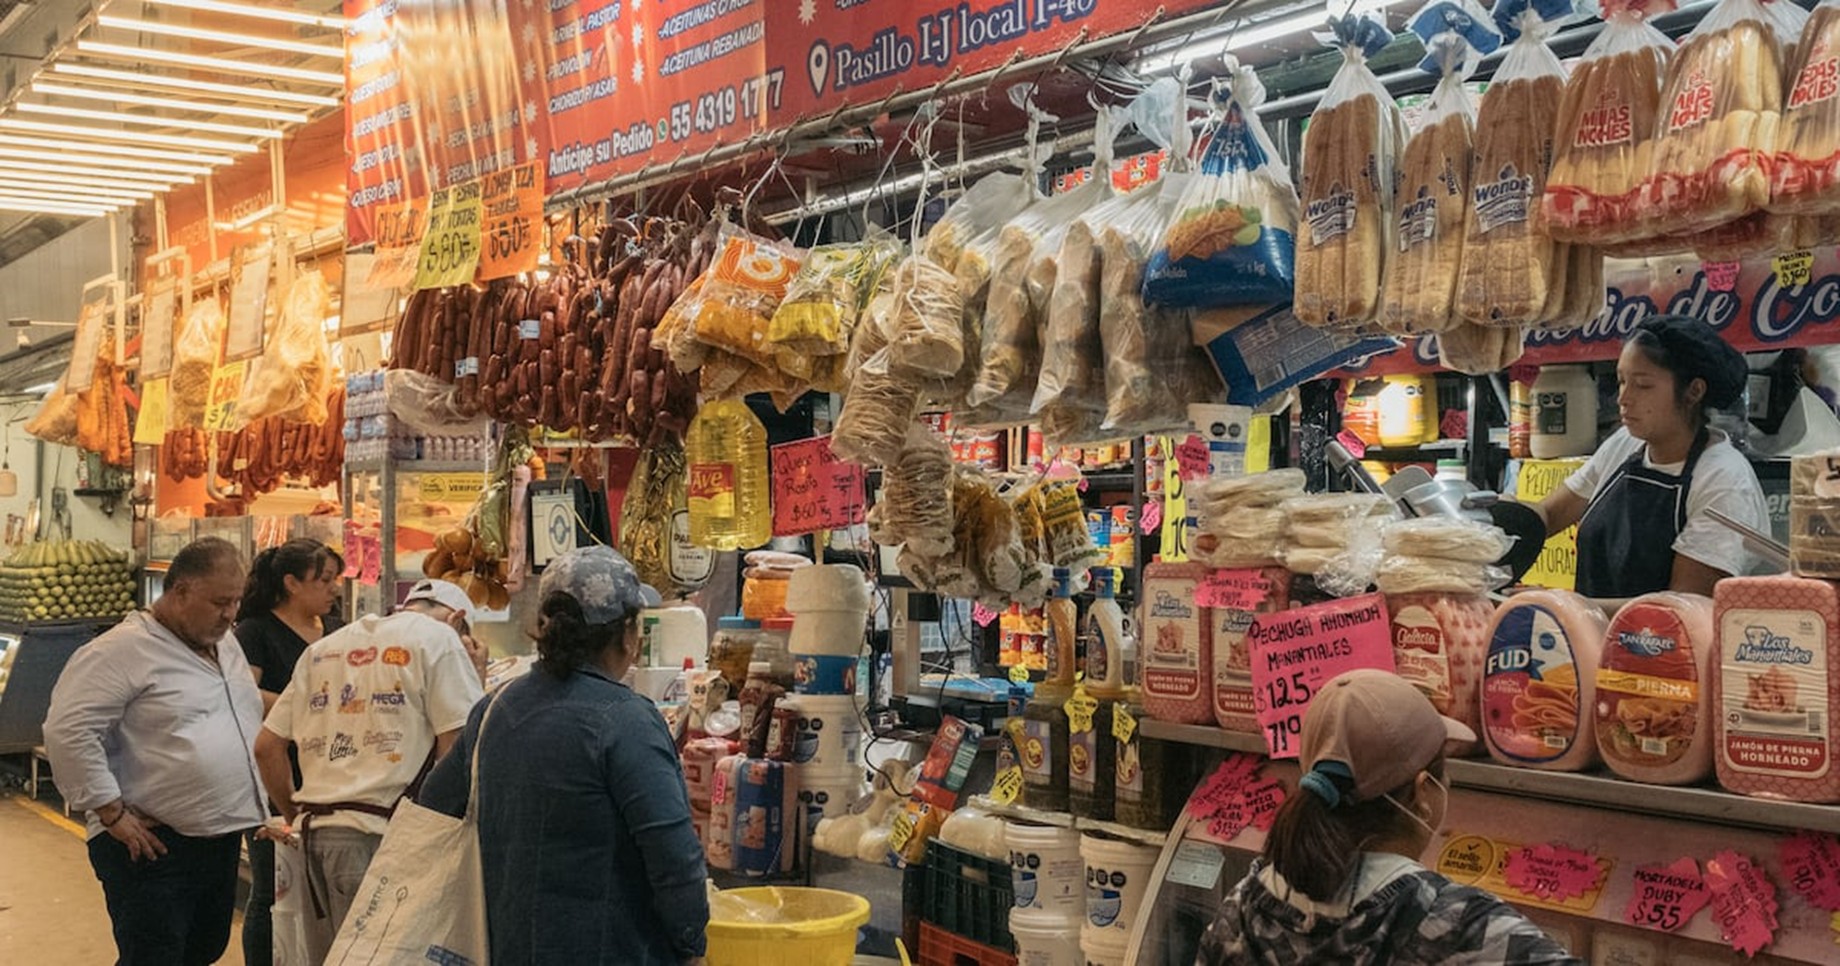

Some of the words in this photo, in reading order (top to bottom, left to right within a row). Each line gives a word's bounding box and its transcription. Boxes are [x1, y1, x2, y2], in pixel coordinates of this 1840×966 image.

[586, 1, 620, 30] PASTOR
[711, 19, 765, 58] REBANADA
[835, 34, 912, 88] Pasillo
[920, 15, 950, 62] I-J
[960, 0, 1026, 48] local
[548, 141, 595, 177] Anticipe
[596, 138, 611, 163] su
[611, 124, 653, 158] Pedido
[670, 102, 691, 142] 55
[695, 86, 736, 134] 4319
[740, 68, 785, 119] 1777
[1254, 260, 1267, 277] kg
[1671, 270, 1736, 326] de
[691, 469, 724, 491] Ave
[1249, 618, 1313, 651] PECHUGA
[1764, 635, 1789, 650] Los
[1487, 648, 1530, 675] FUD
[1736, 645, 1812, 664] Manantiales
[1731, 741, 1763, 752] JAMÓN
[1766, 744, 1779, 753] DE
[1782, 744, 1820, 757] PIERNA
[1740, 752, 1810, 767] HORNEADO
[1634, 870, 1704, 892] MORTADELA
[1643, 886, 1686, 903] DUBY
[1632, 901, 1682, 930] $55
